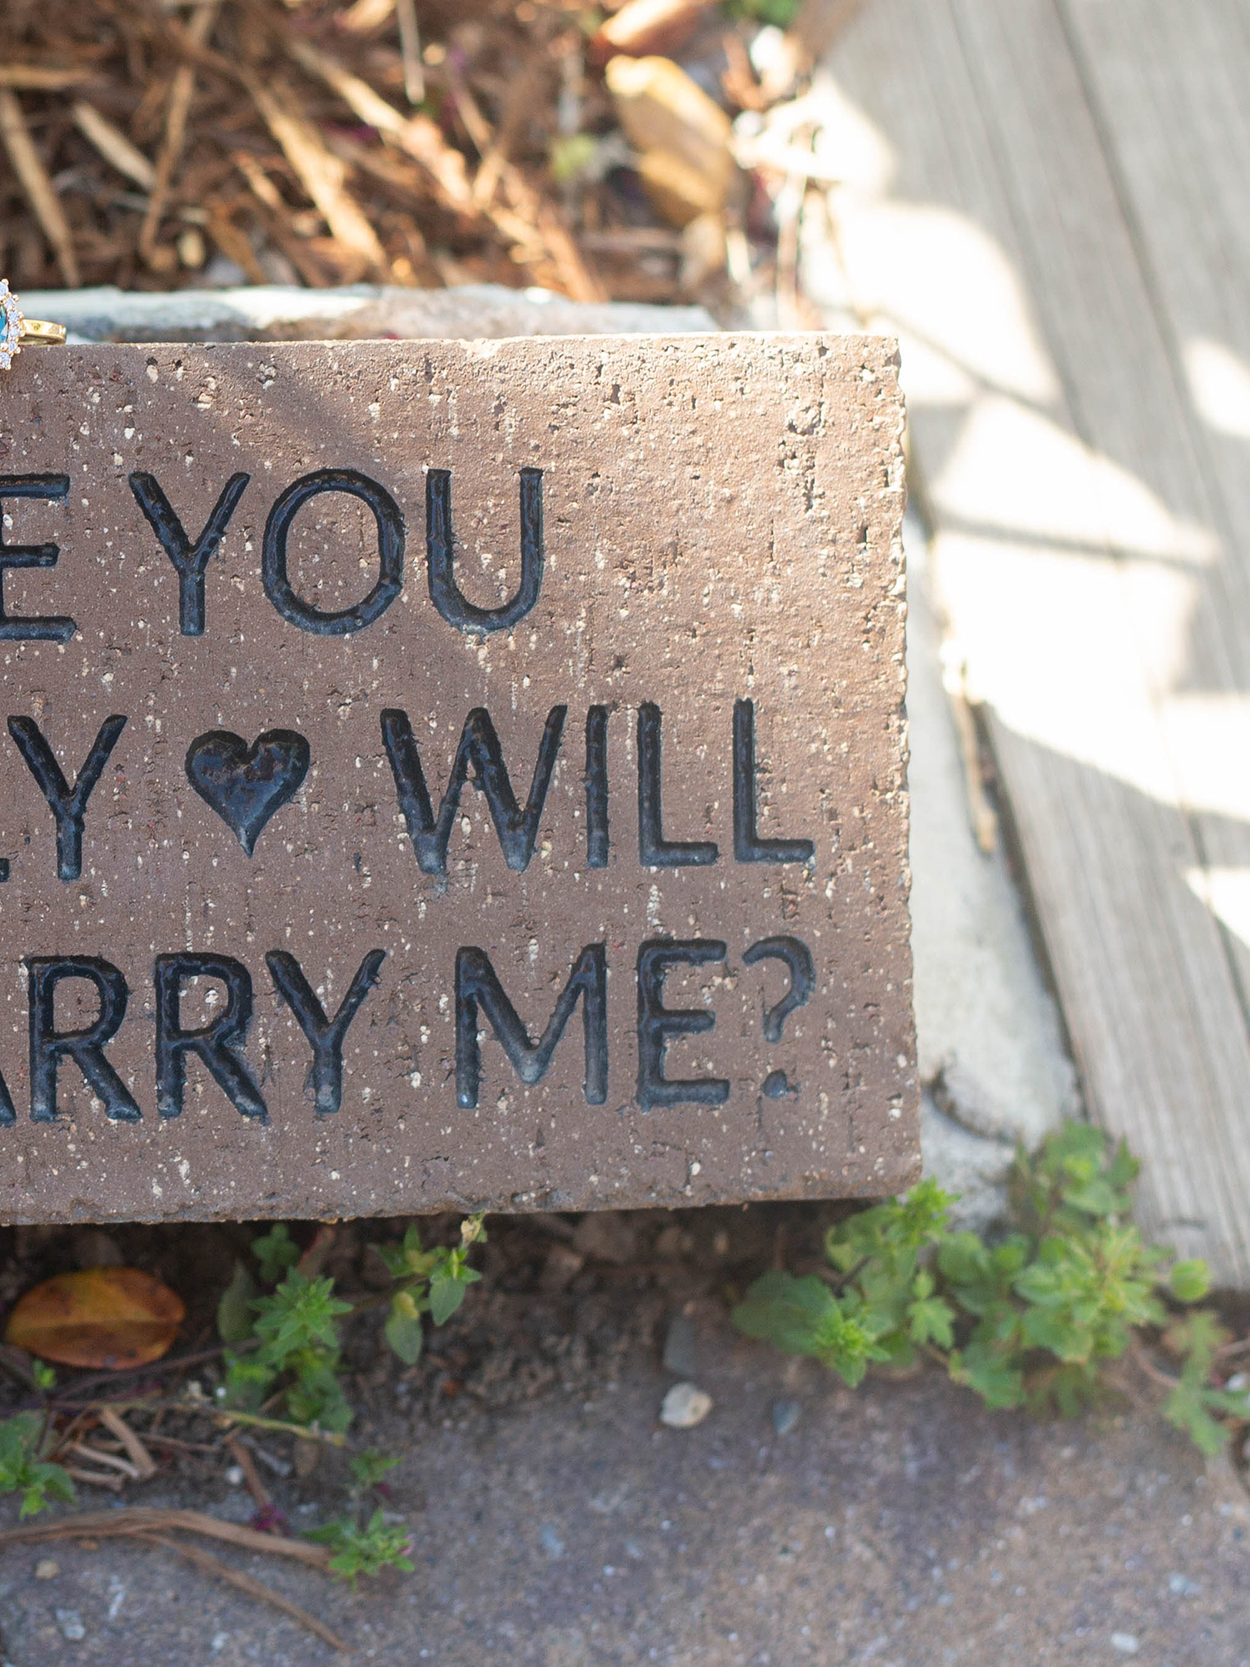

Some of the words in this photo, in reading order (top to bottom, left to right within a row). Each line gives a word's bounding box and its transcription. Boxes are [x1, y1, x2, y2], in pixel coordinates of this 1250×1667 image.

[128, 467, 544, 637] YOU
[379, 699, 815, 875] WILL
[453, 934, 817, 1112] ME?
